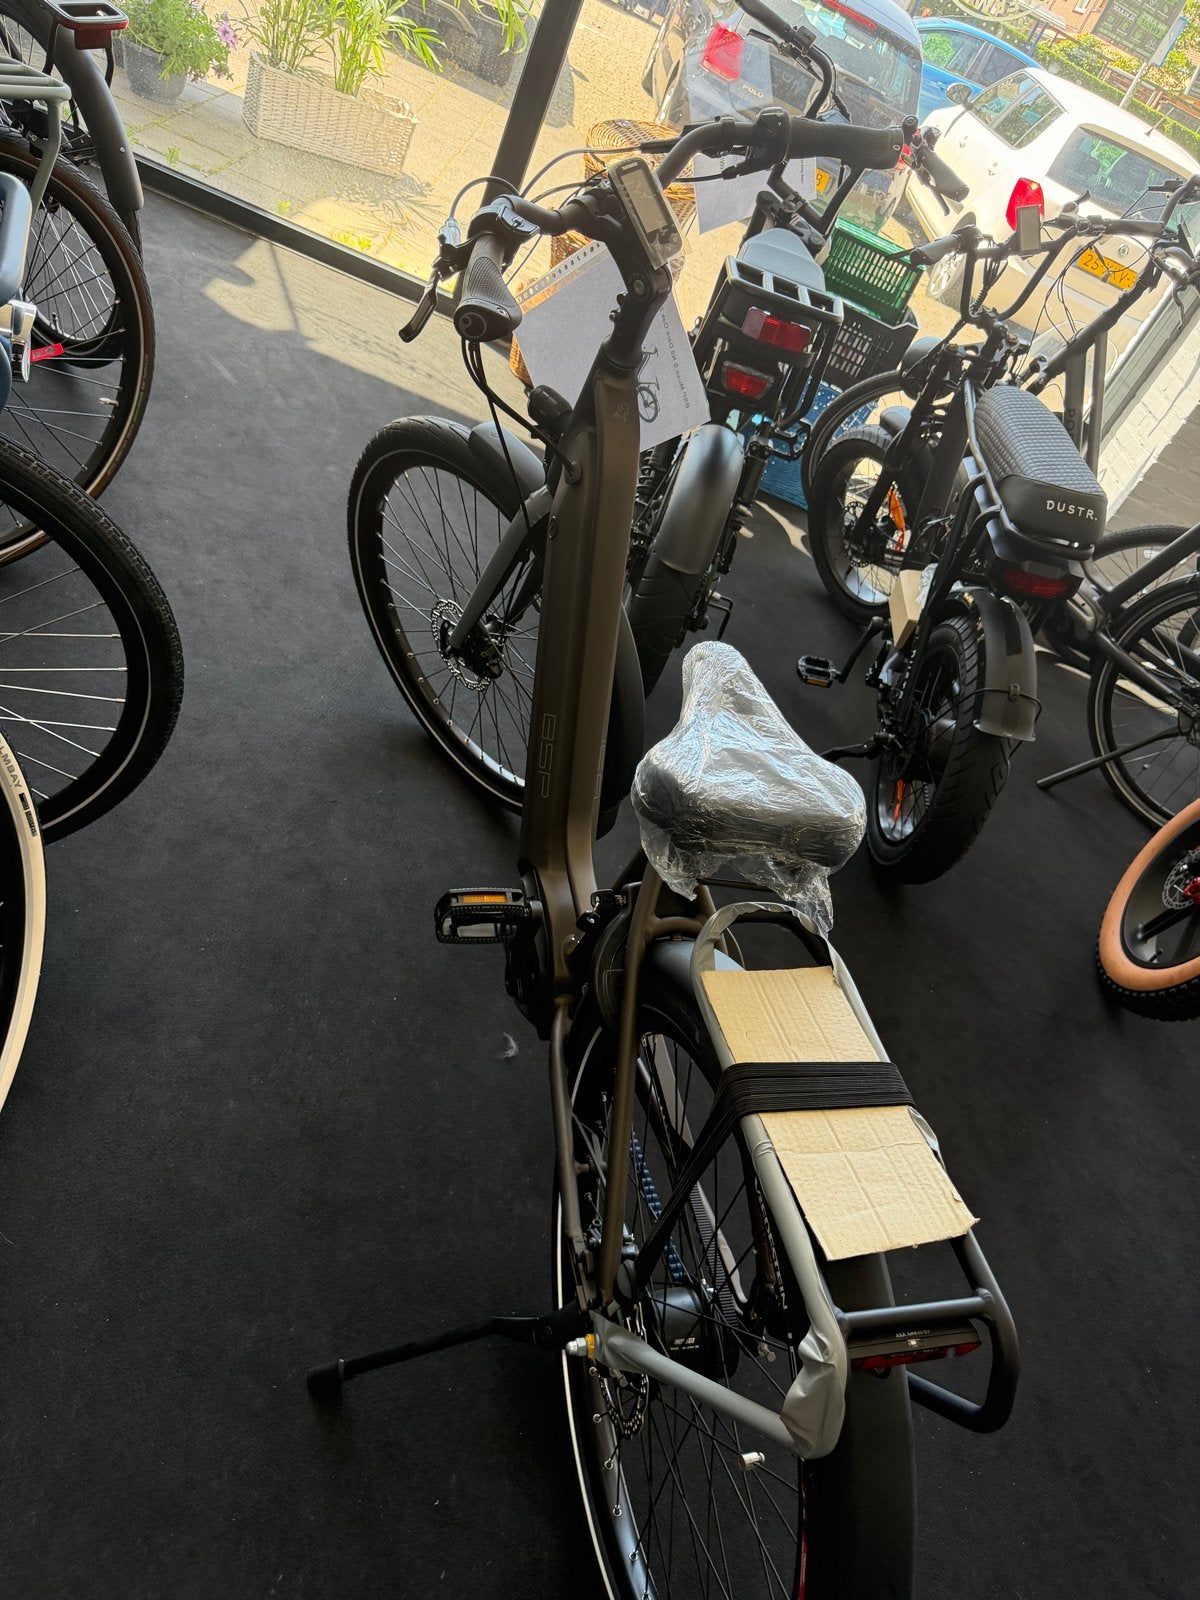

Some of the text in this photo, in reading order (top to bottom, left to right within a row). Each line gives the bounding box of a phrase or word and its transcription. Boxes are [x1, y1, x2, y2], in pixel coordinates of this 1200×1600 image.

[742, 84, 764, 98] POLO
[1065, 408, 1076, 438] PO
[1046, 500, 1098, 521] DUSTR.
[0, 742, 23, 789] LMBAY
[537, 713, 556, 798] BSP
